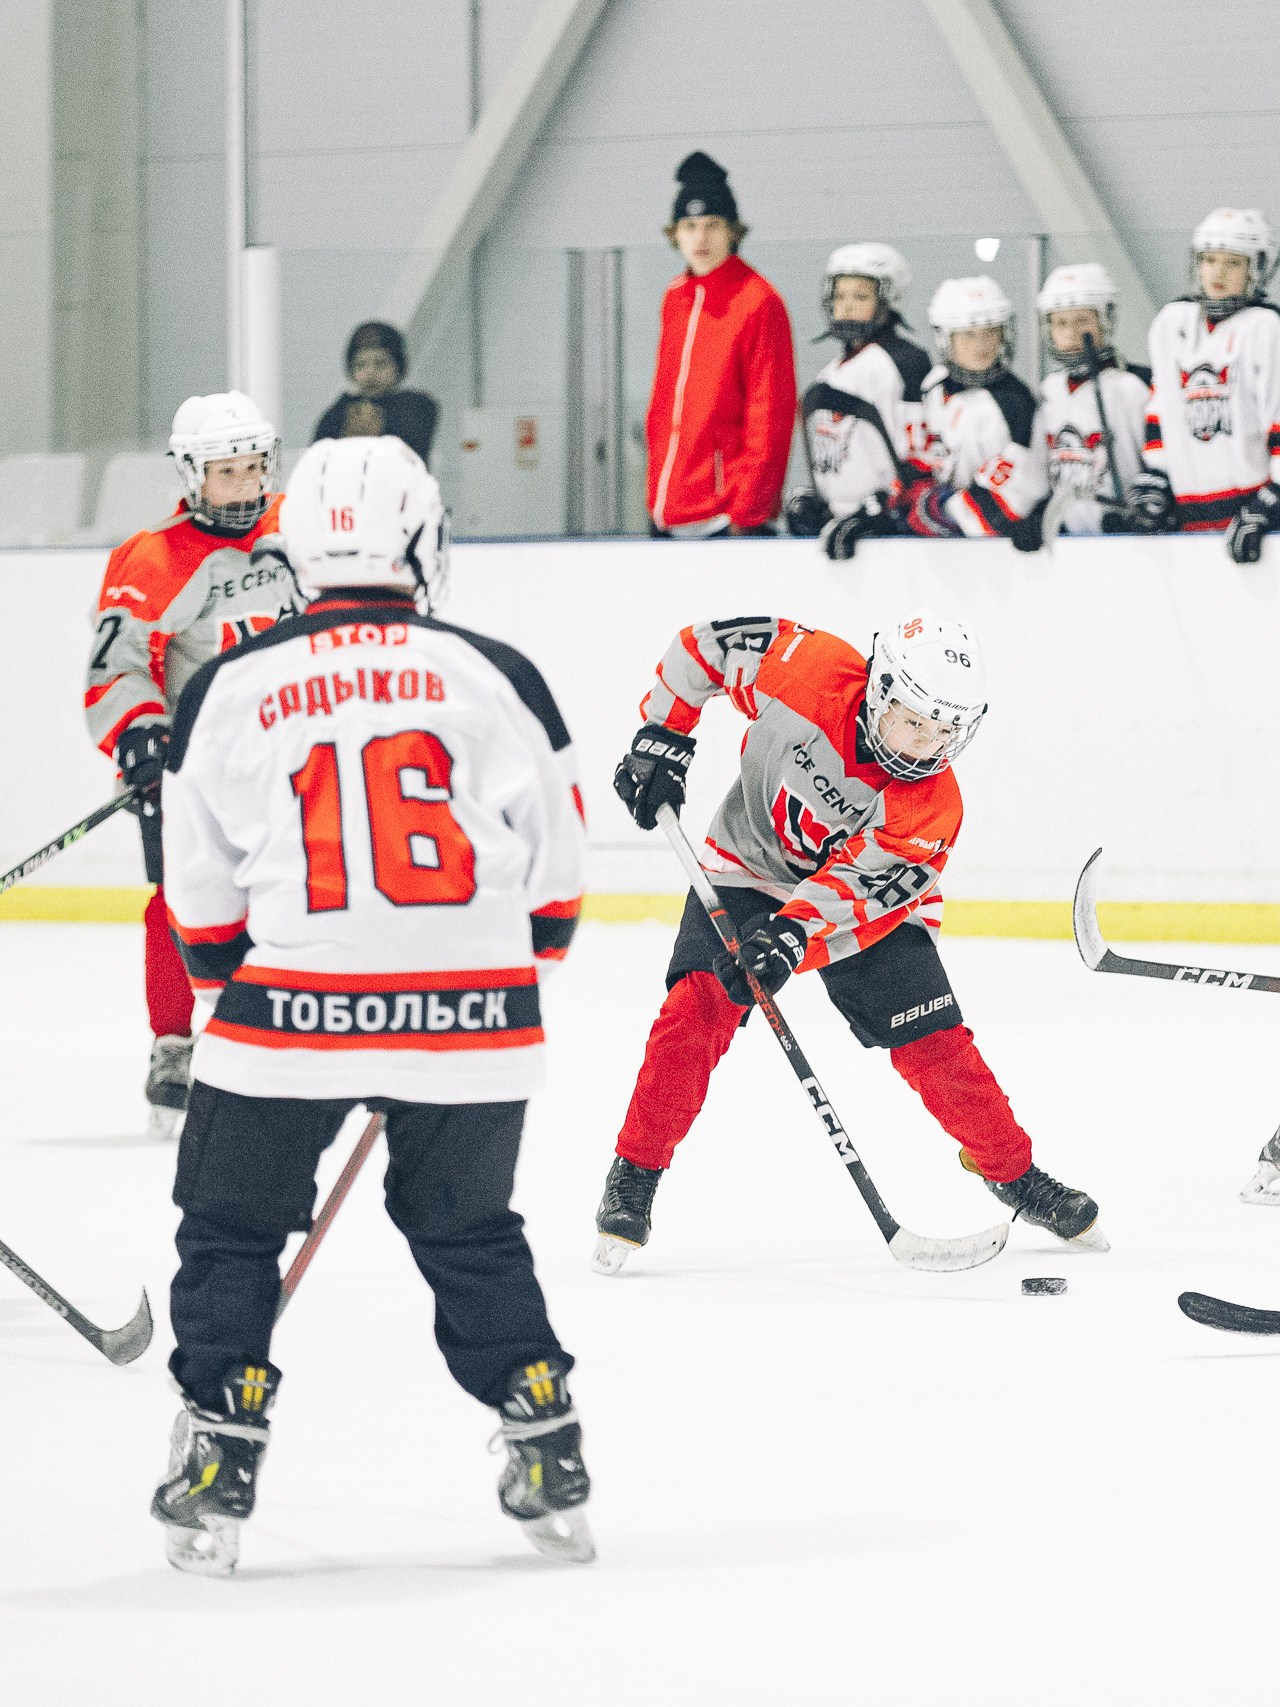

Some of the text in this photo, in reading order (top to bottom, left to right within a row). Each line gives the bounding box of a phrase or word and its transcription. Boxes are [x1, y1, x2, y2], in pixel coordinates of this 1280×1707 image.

[328, 507, 355, 532] 16
[311, 623, 409, 652] STOP
[903, 617, 924, 639] 96
[944, 648, 972, 669] 96
[258, 667, 446, 732] САДЫКОВ
[792, 741, 817, 773] ICE
[289, 728, 478, 915] 16
[1173, 966, 1255, 990] CCM
[266, 988, 510, 1033] ТОБОЛЬСК
[889, 993, 954, 1029] BAUER
[801, 1076, 860, 1165] CCM
